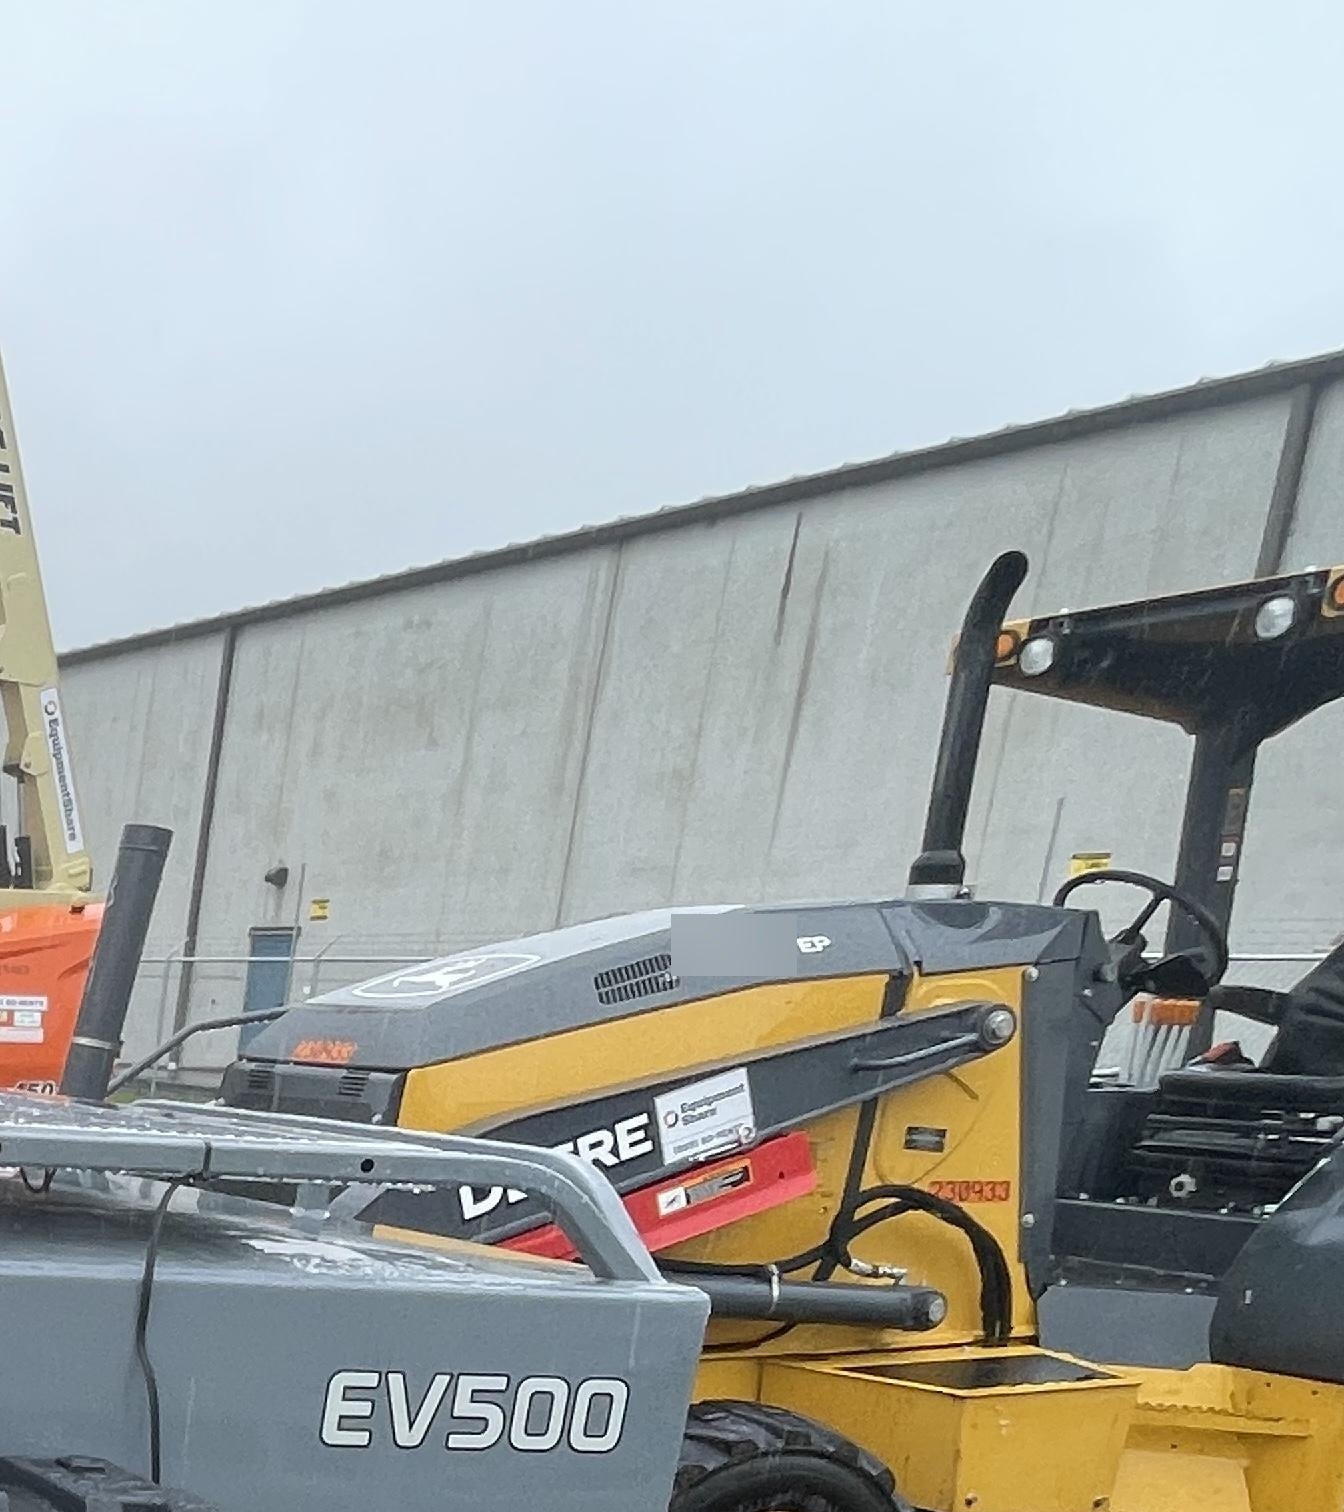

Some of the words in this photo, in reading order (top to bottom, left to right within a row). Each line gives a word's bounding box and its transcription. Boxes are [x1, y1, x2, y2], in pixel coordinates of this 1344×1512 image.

[48, 717, 77, 842] EquipmentShare
[459, 1112, 654, 1221] DRE
[319, 1369, 630, 1453] EV500
